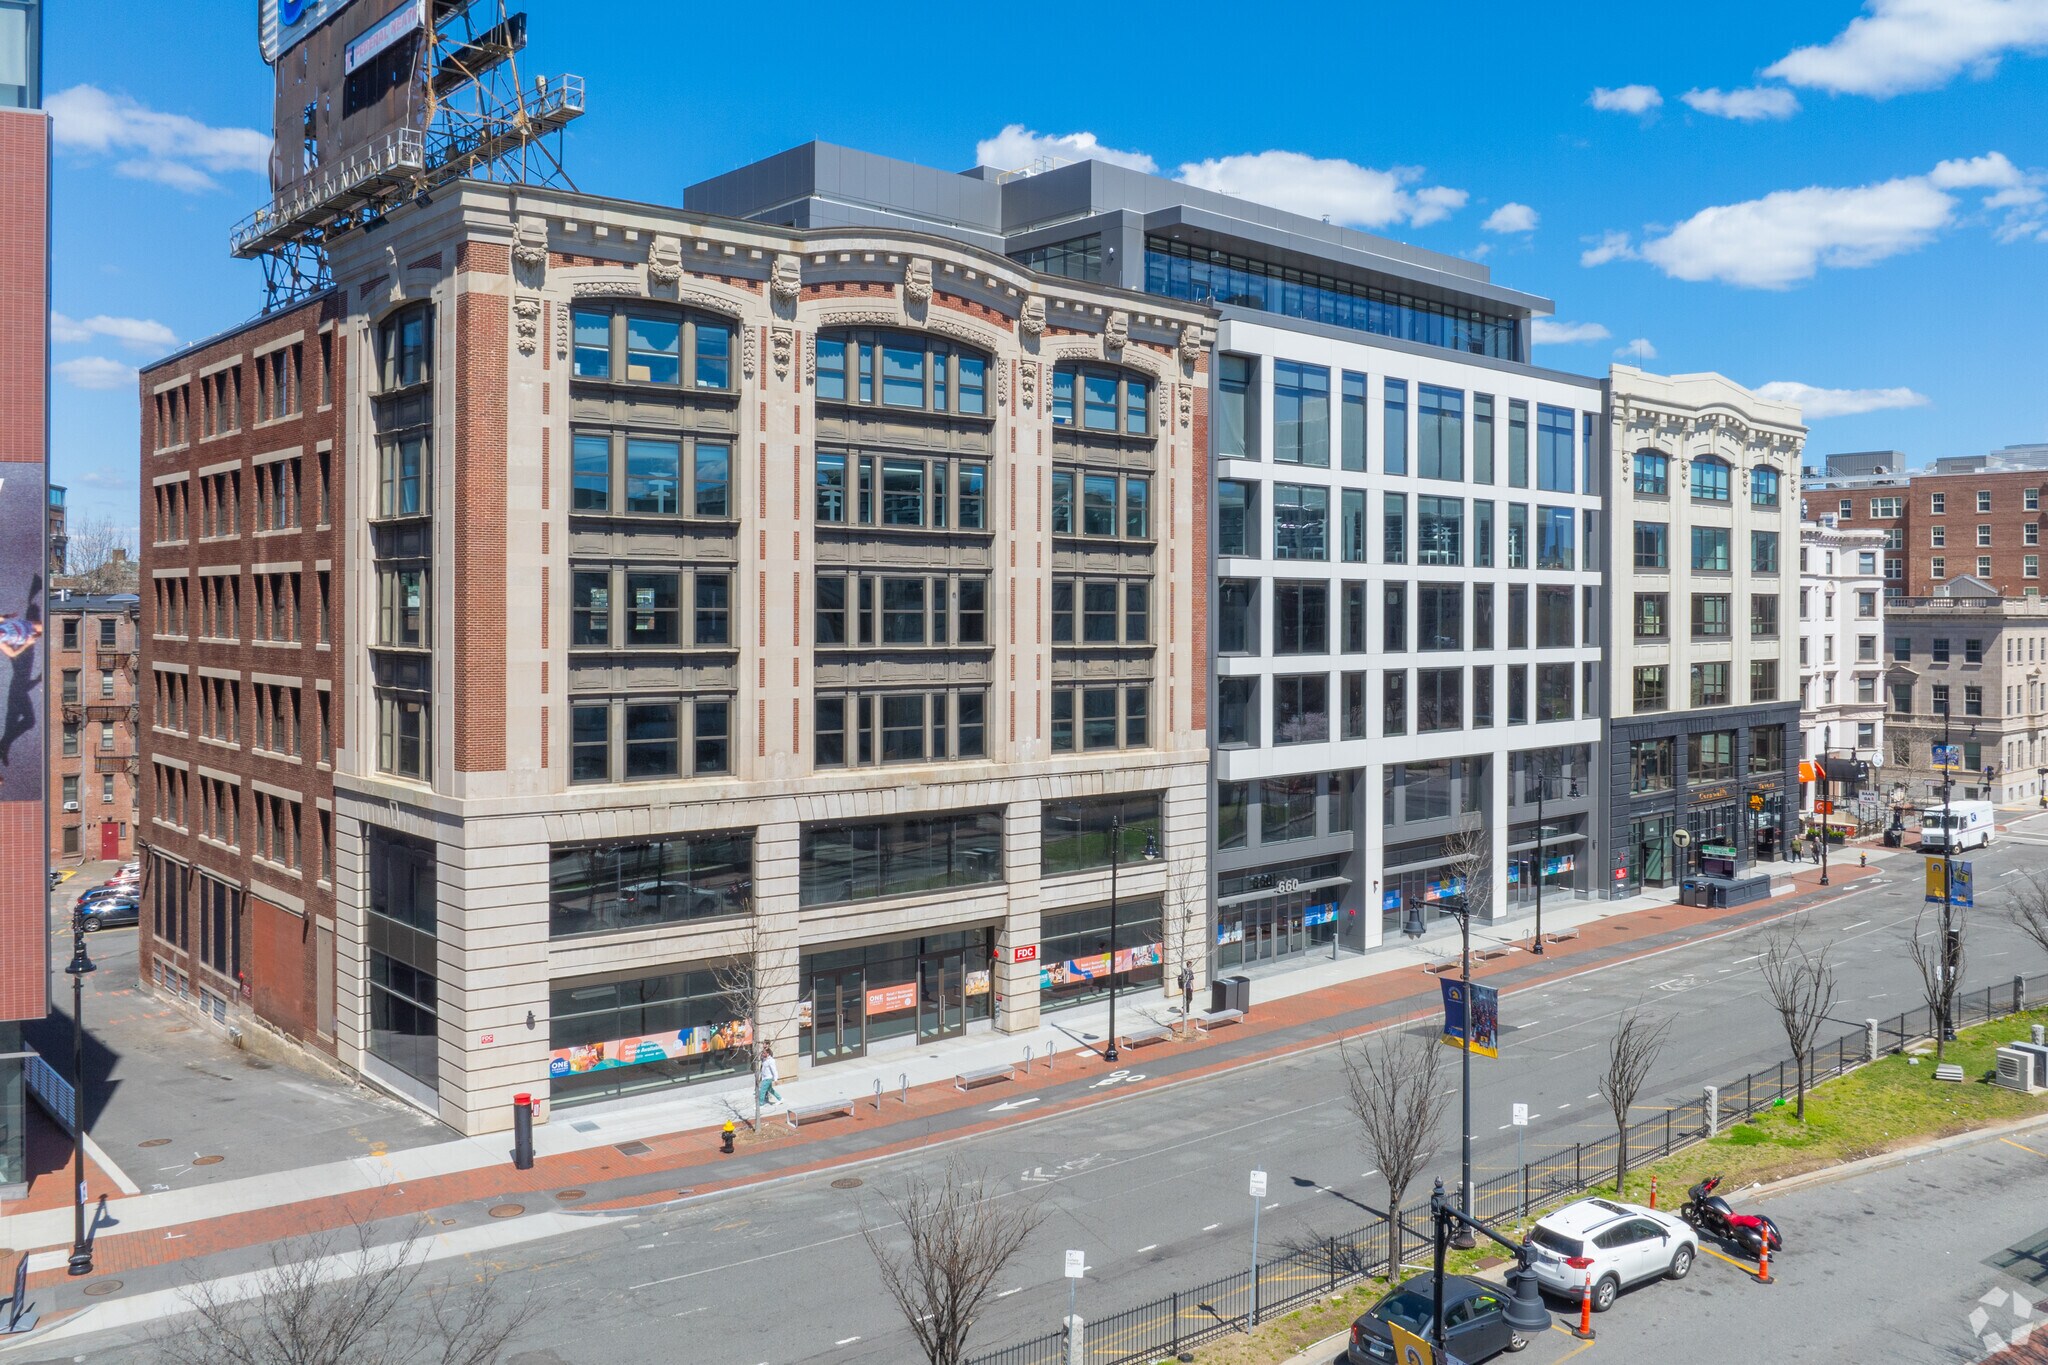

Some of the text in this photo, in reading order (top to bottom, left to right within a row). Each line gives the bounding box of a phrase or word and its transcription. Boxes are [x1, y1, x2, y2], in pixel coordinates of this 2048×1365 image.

[355, 26, 388, 58] FEDERAL
[1675, 834, 1687, 845] T
[1278, 878, 1299, 893] 660
[1017, 947, 1033, 958] FDC
[551, 1061, 568, 1069] ONE
